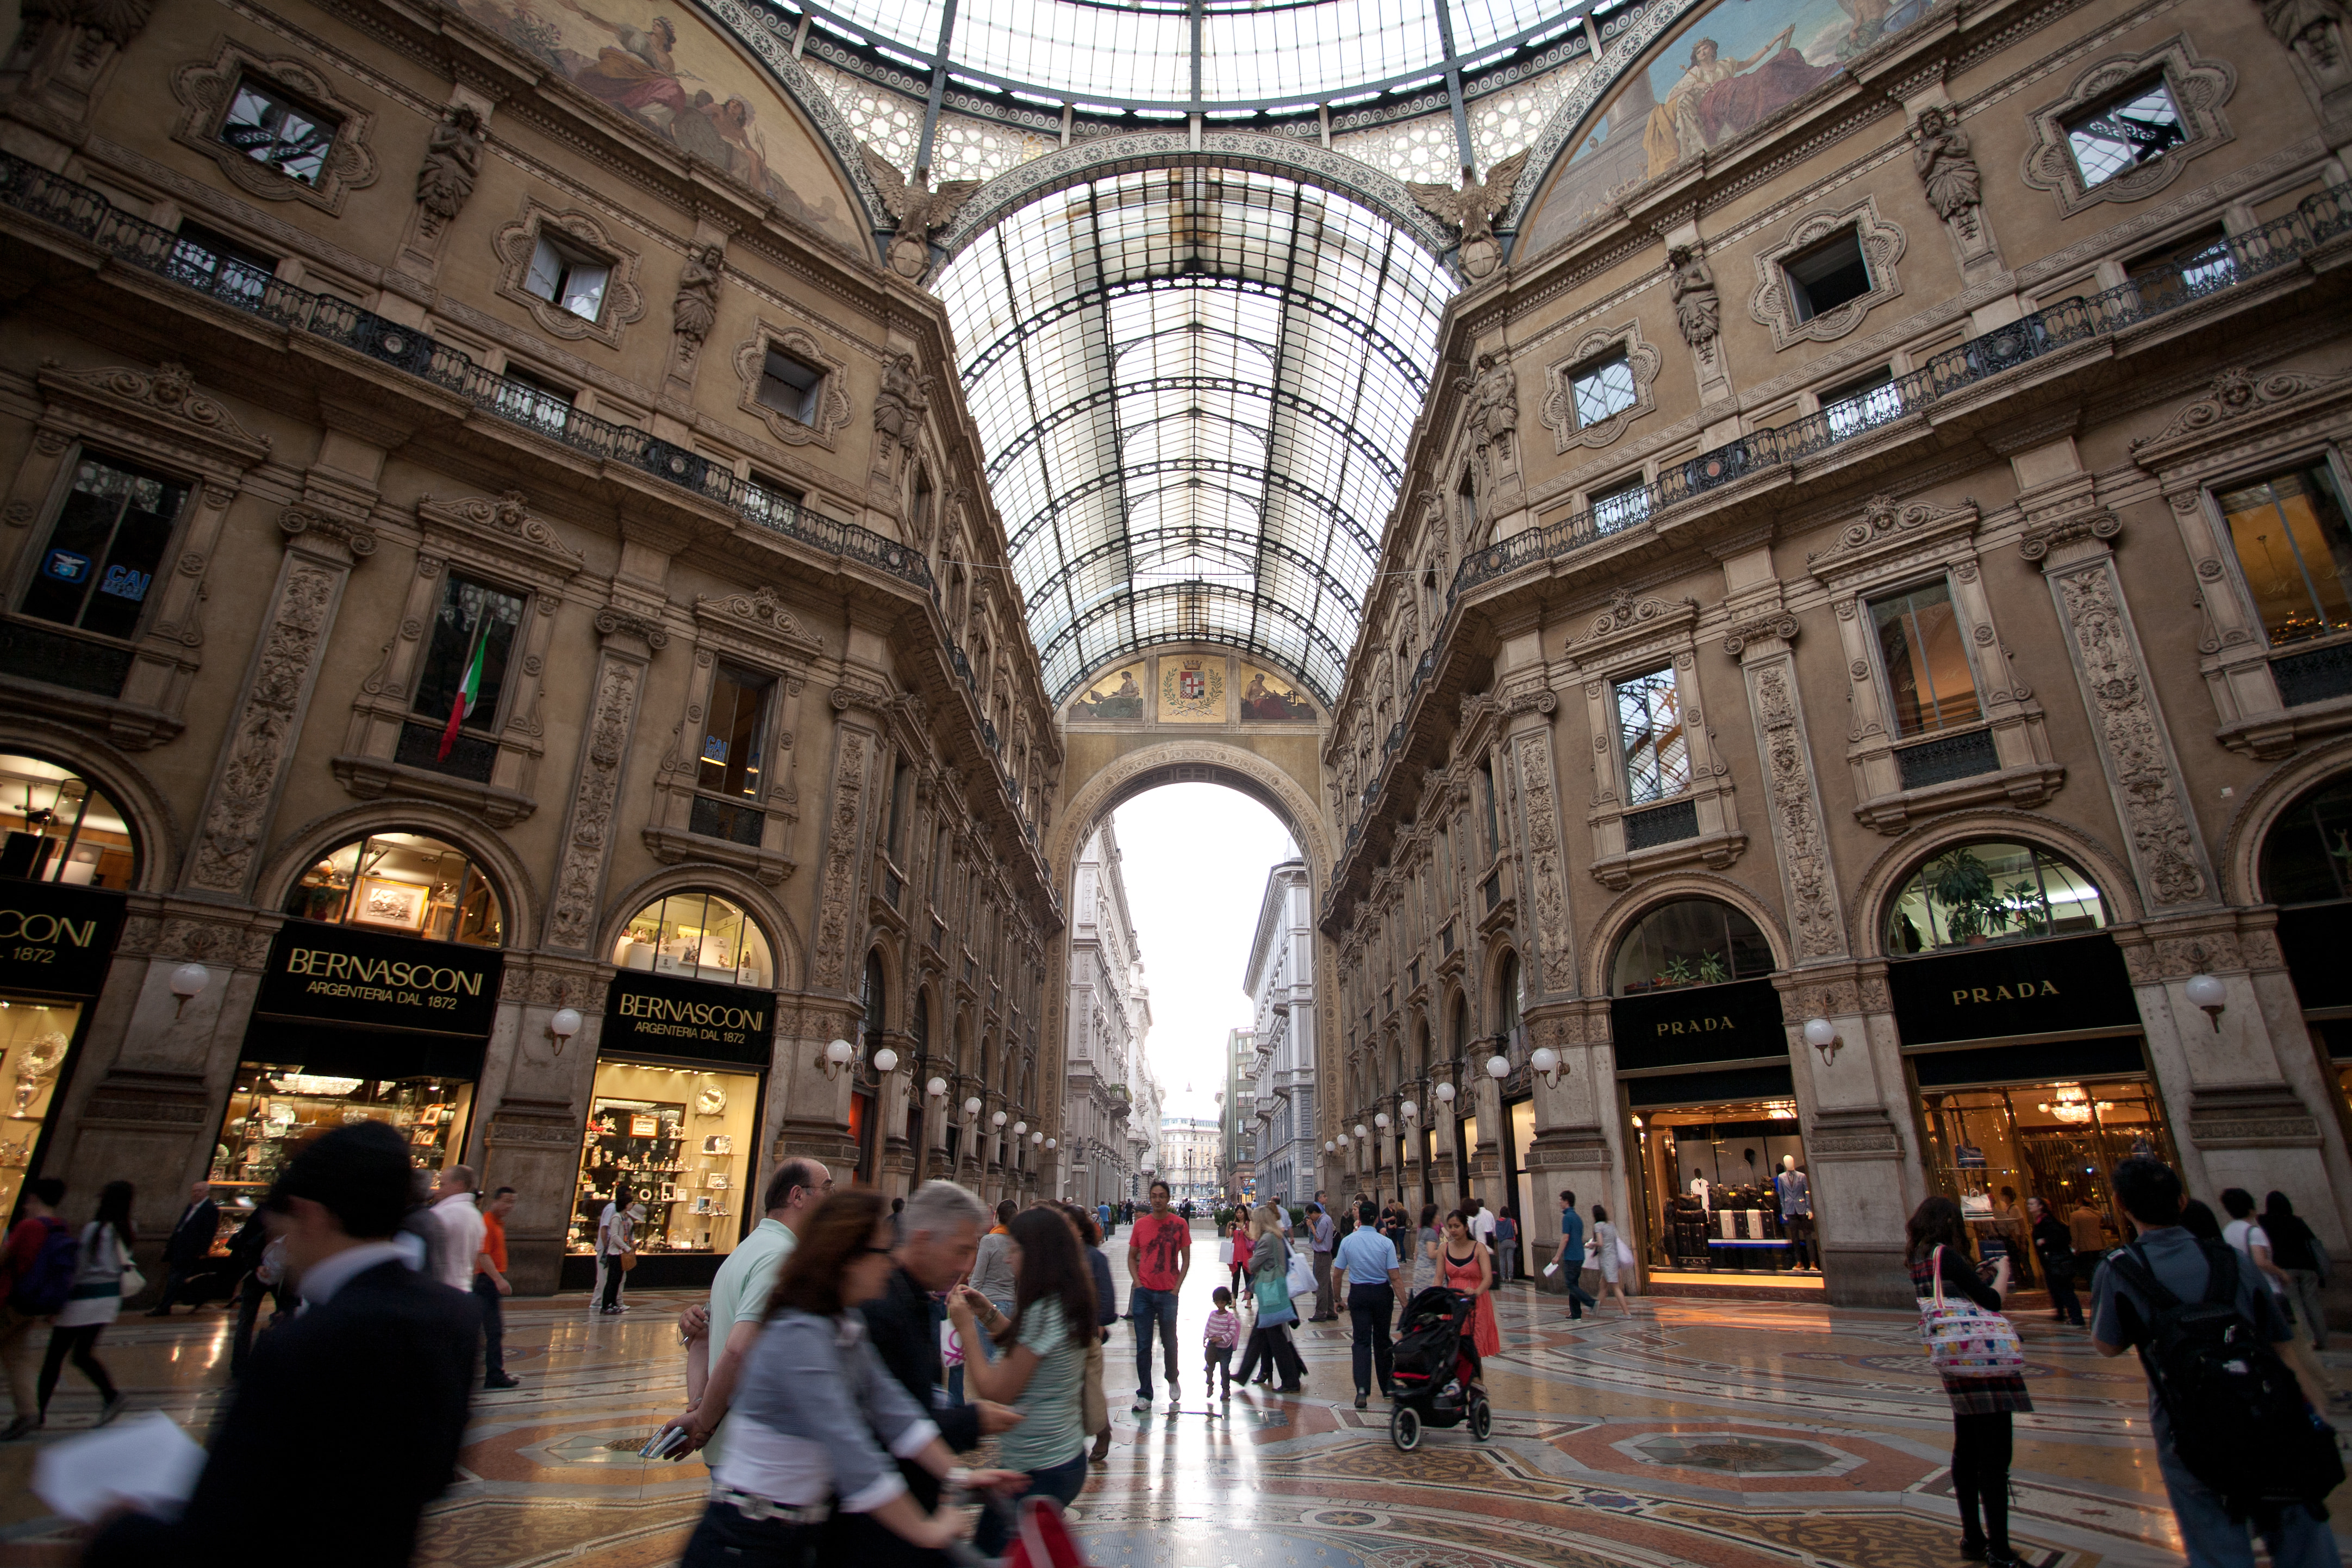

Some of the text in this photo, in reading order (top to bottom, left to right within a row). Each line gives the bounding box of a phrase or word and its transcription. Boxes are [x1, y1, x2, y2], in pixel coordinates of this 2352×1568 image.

[108, 565, 152, 590] CAI
[706, 735, 727, 754] CAI
[13, 946, 56, 964] 1872
[287, 948, 483, 996] BERNASCONI
[306, 980, 457, 1010] ARGENTERIA DAL 1872
[1952, 980, 2060, 1005] PRADA
[619, 994, 763, 1032] BERNASCONI
[634, 1021, 745, 1044] ARGENTERIA DAL 1872
[1657, 1016, 1735, 1036] PRADA
